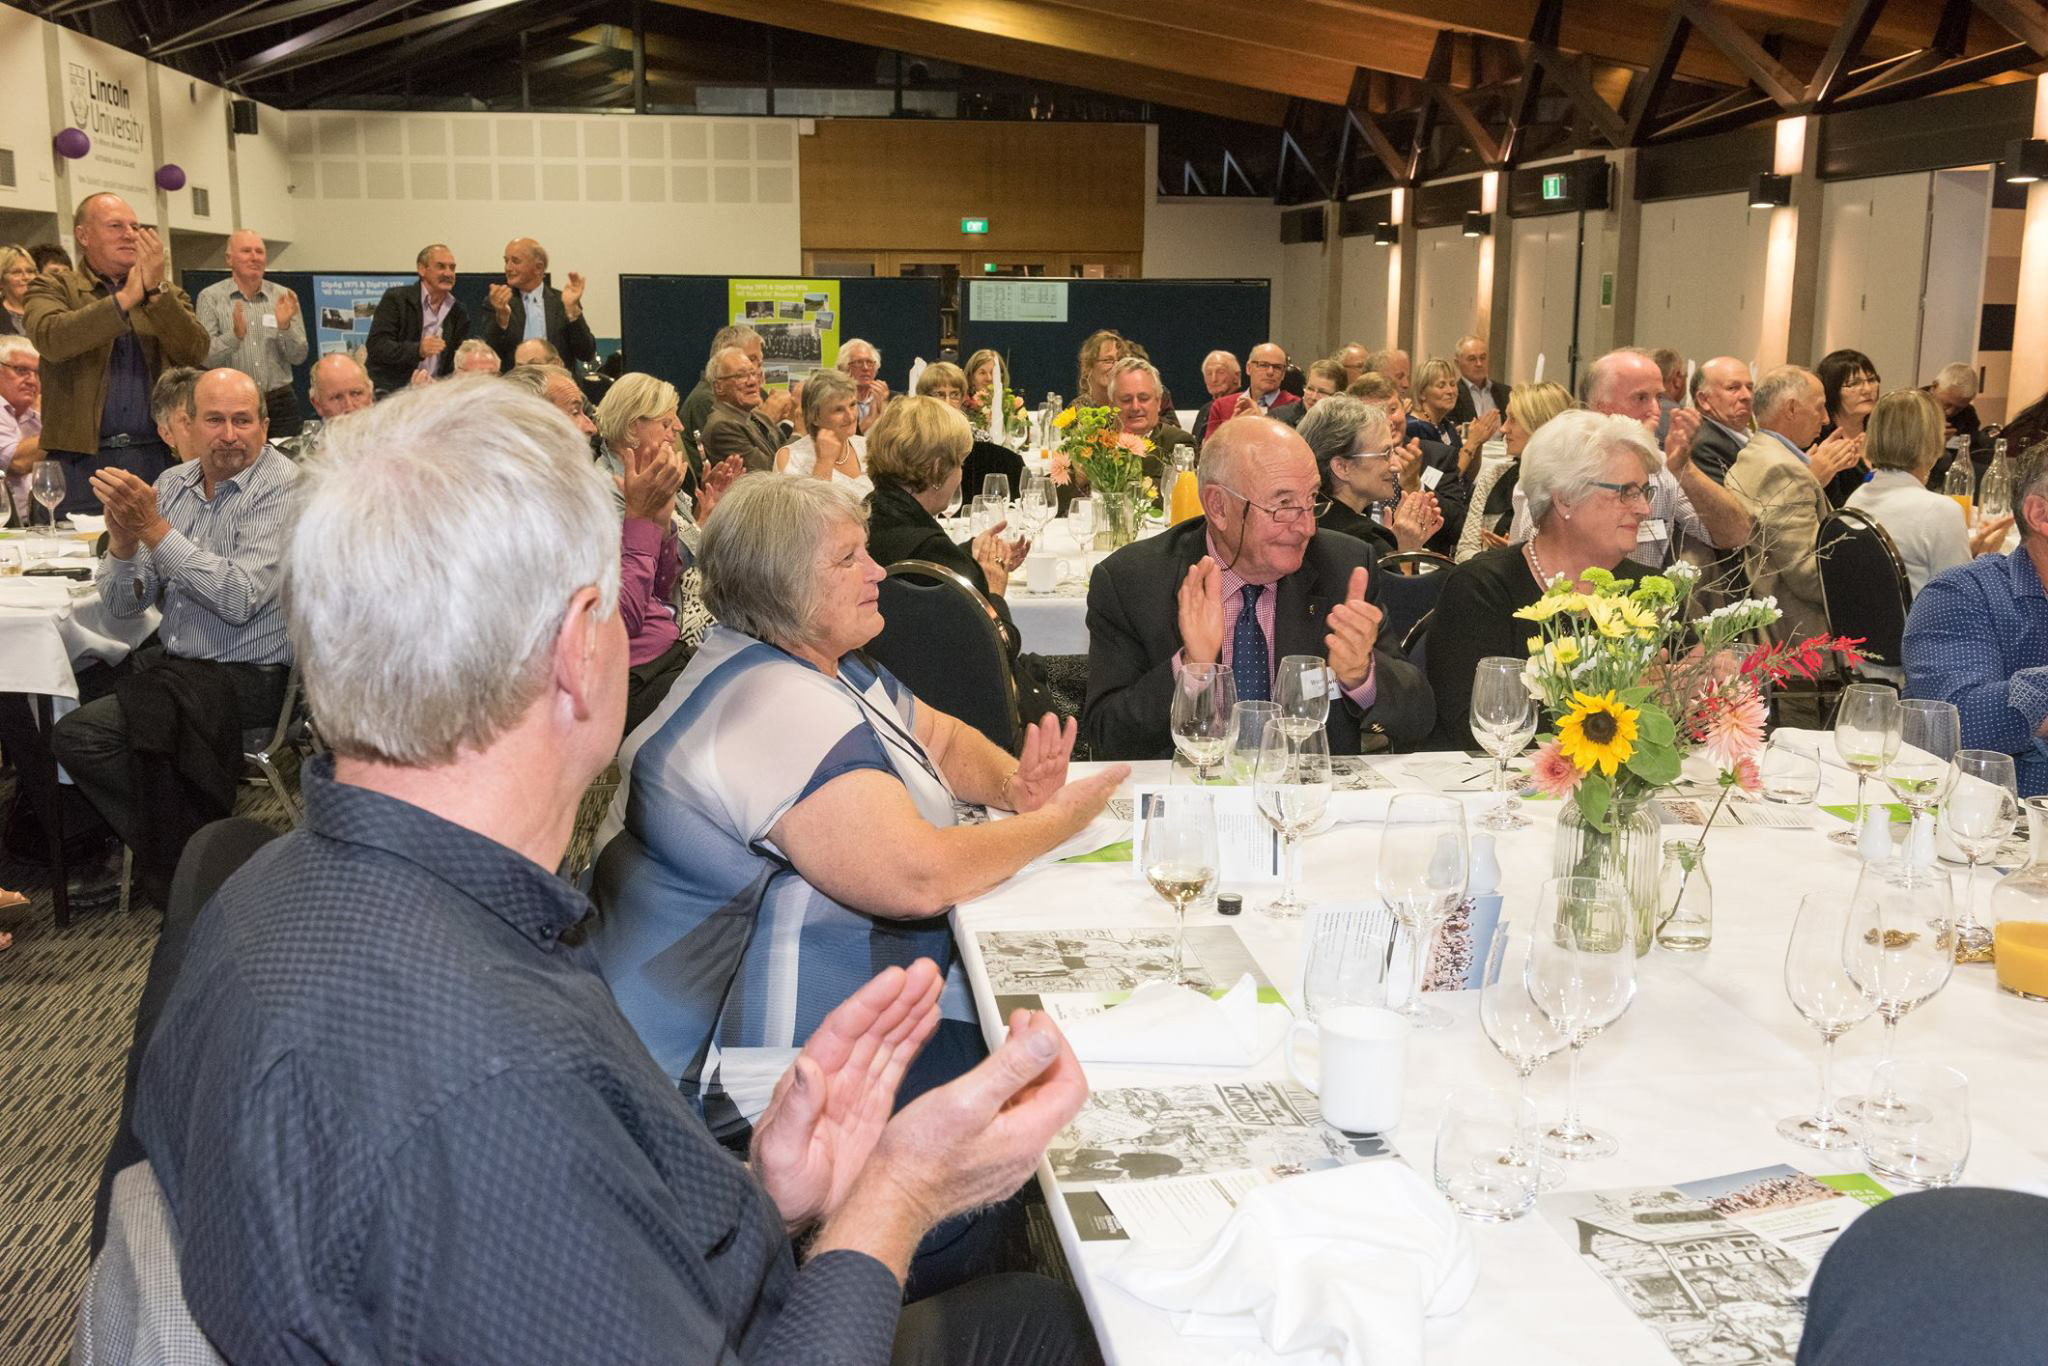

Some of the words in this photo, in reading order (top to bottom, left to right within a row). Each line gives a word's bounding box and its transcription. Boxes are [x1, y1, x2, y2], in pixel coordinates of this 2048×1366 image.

[88, 69, 130, 109] Lincoln
[90, 102, 144, 152] University
[1678, 1250, 1731, 1268] TAI
[1735, 1246, 1788, 1262] TAI
